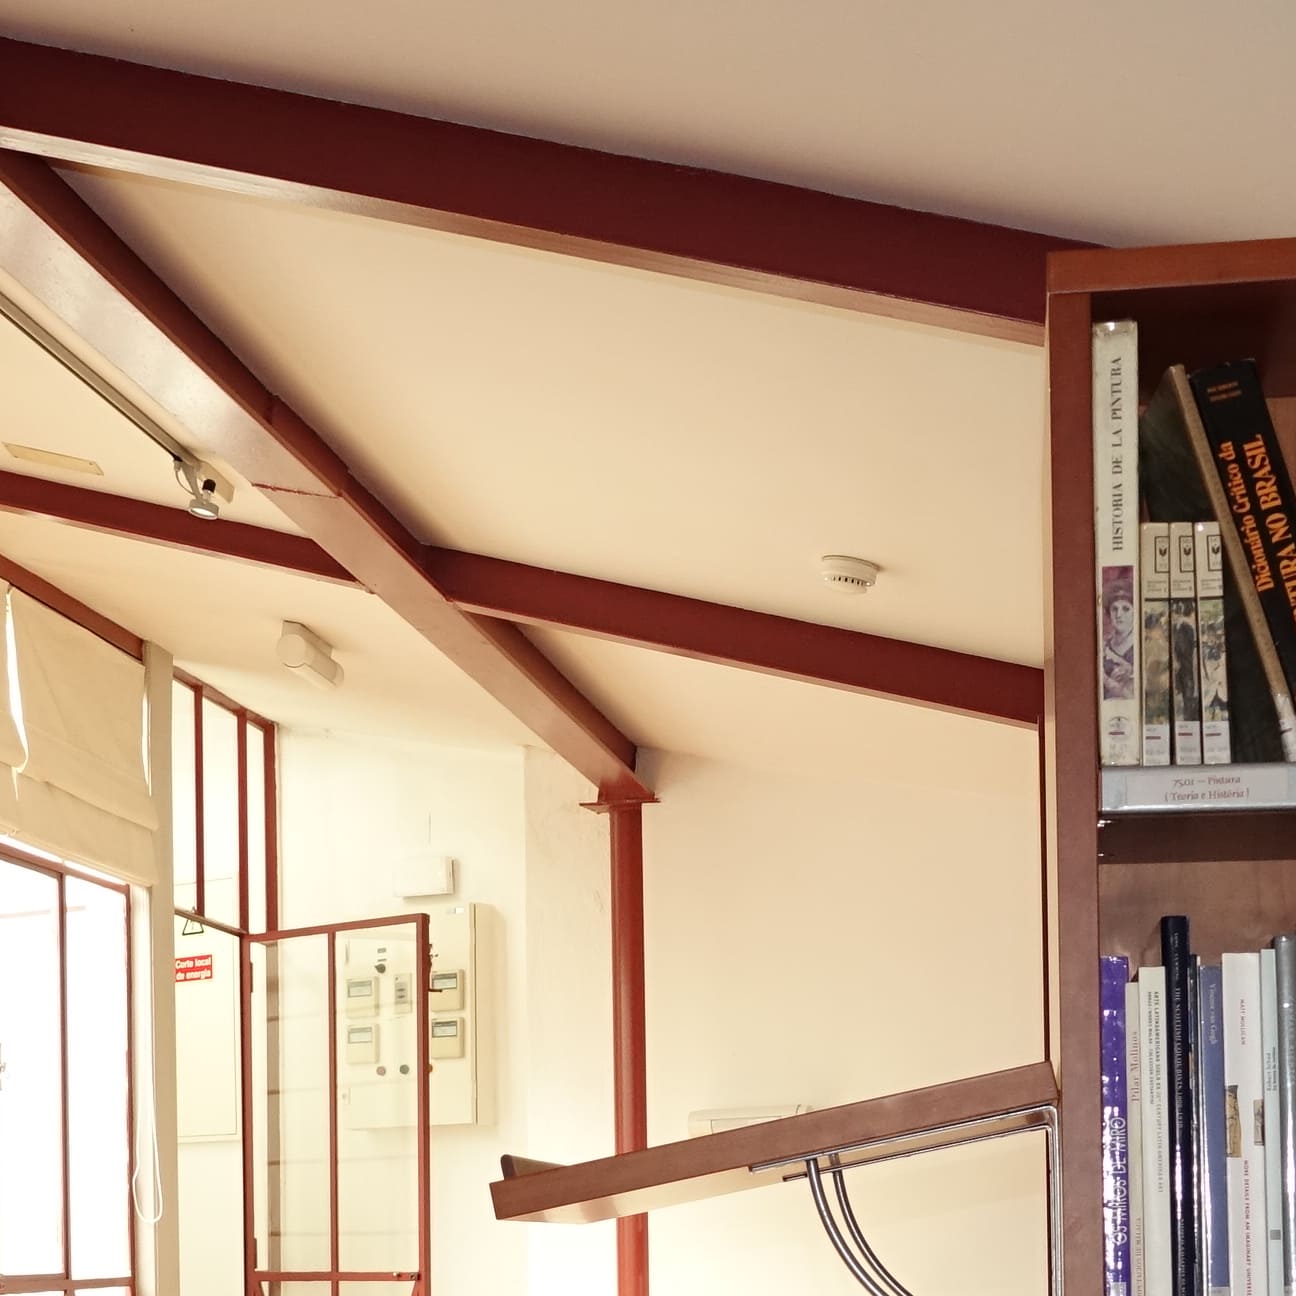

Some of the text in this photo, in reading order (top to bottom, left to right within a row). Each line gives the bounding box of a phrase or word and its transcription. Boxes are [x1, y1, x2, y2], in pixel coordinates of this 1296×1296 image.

[1110, 356, 1123, 551] HISTORIA DE LA PINTURA
[1218, 441, 1236, 461] da
[1242, 433, 1283, 511] BRASIL
[1264, 510, 1292, 544] NO
